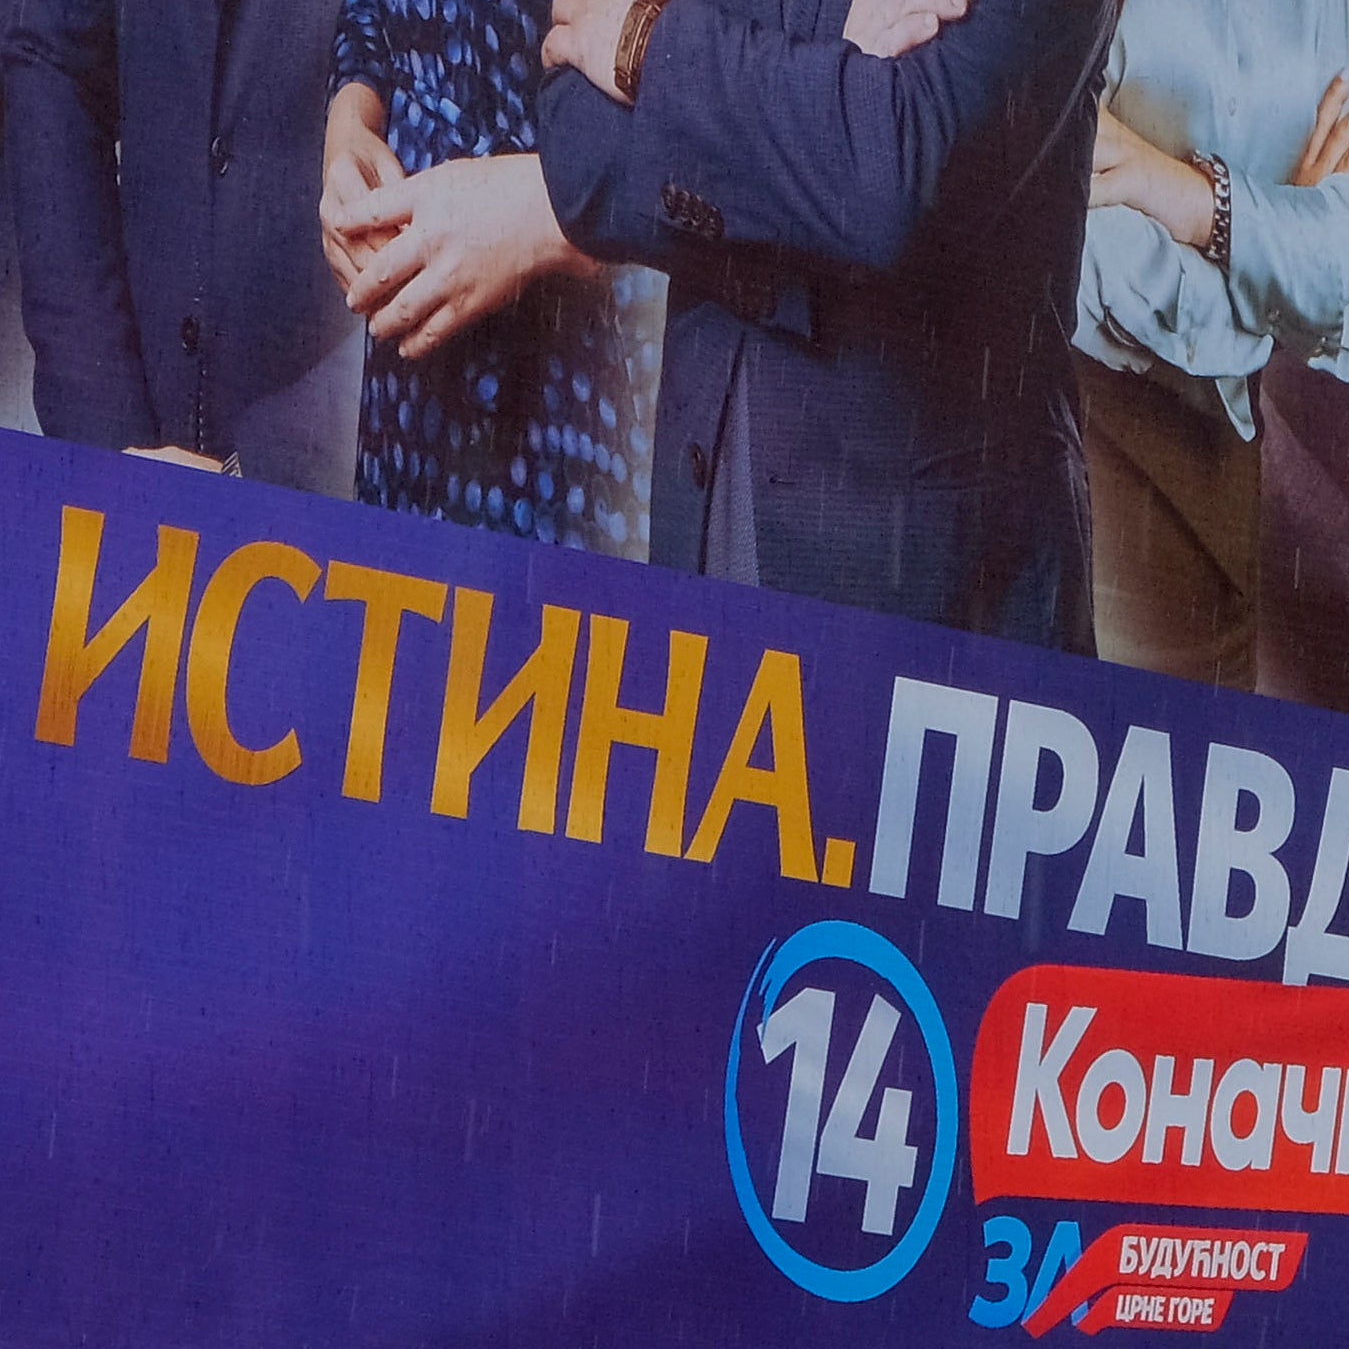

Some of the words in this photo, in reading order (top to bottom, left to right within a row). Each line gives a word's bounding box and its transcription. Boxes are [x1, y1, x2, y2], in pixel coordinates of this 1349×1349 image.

[35, 505, 856, 887] ИСТИНА.
[757, 987, 918, 1235] 14
[1115, 1294, 1165, 1323] ЦРНЕ
[1169, 1296, 1215, 1325] ГОРЕ
[1119, 1236, 1286, 1281] БУДУЋНОСТ
